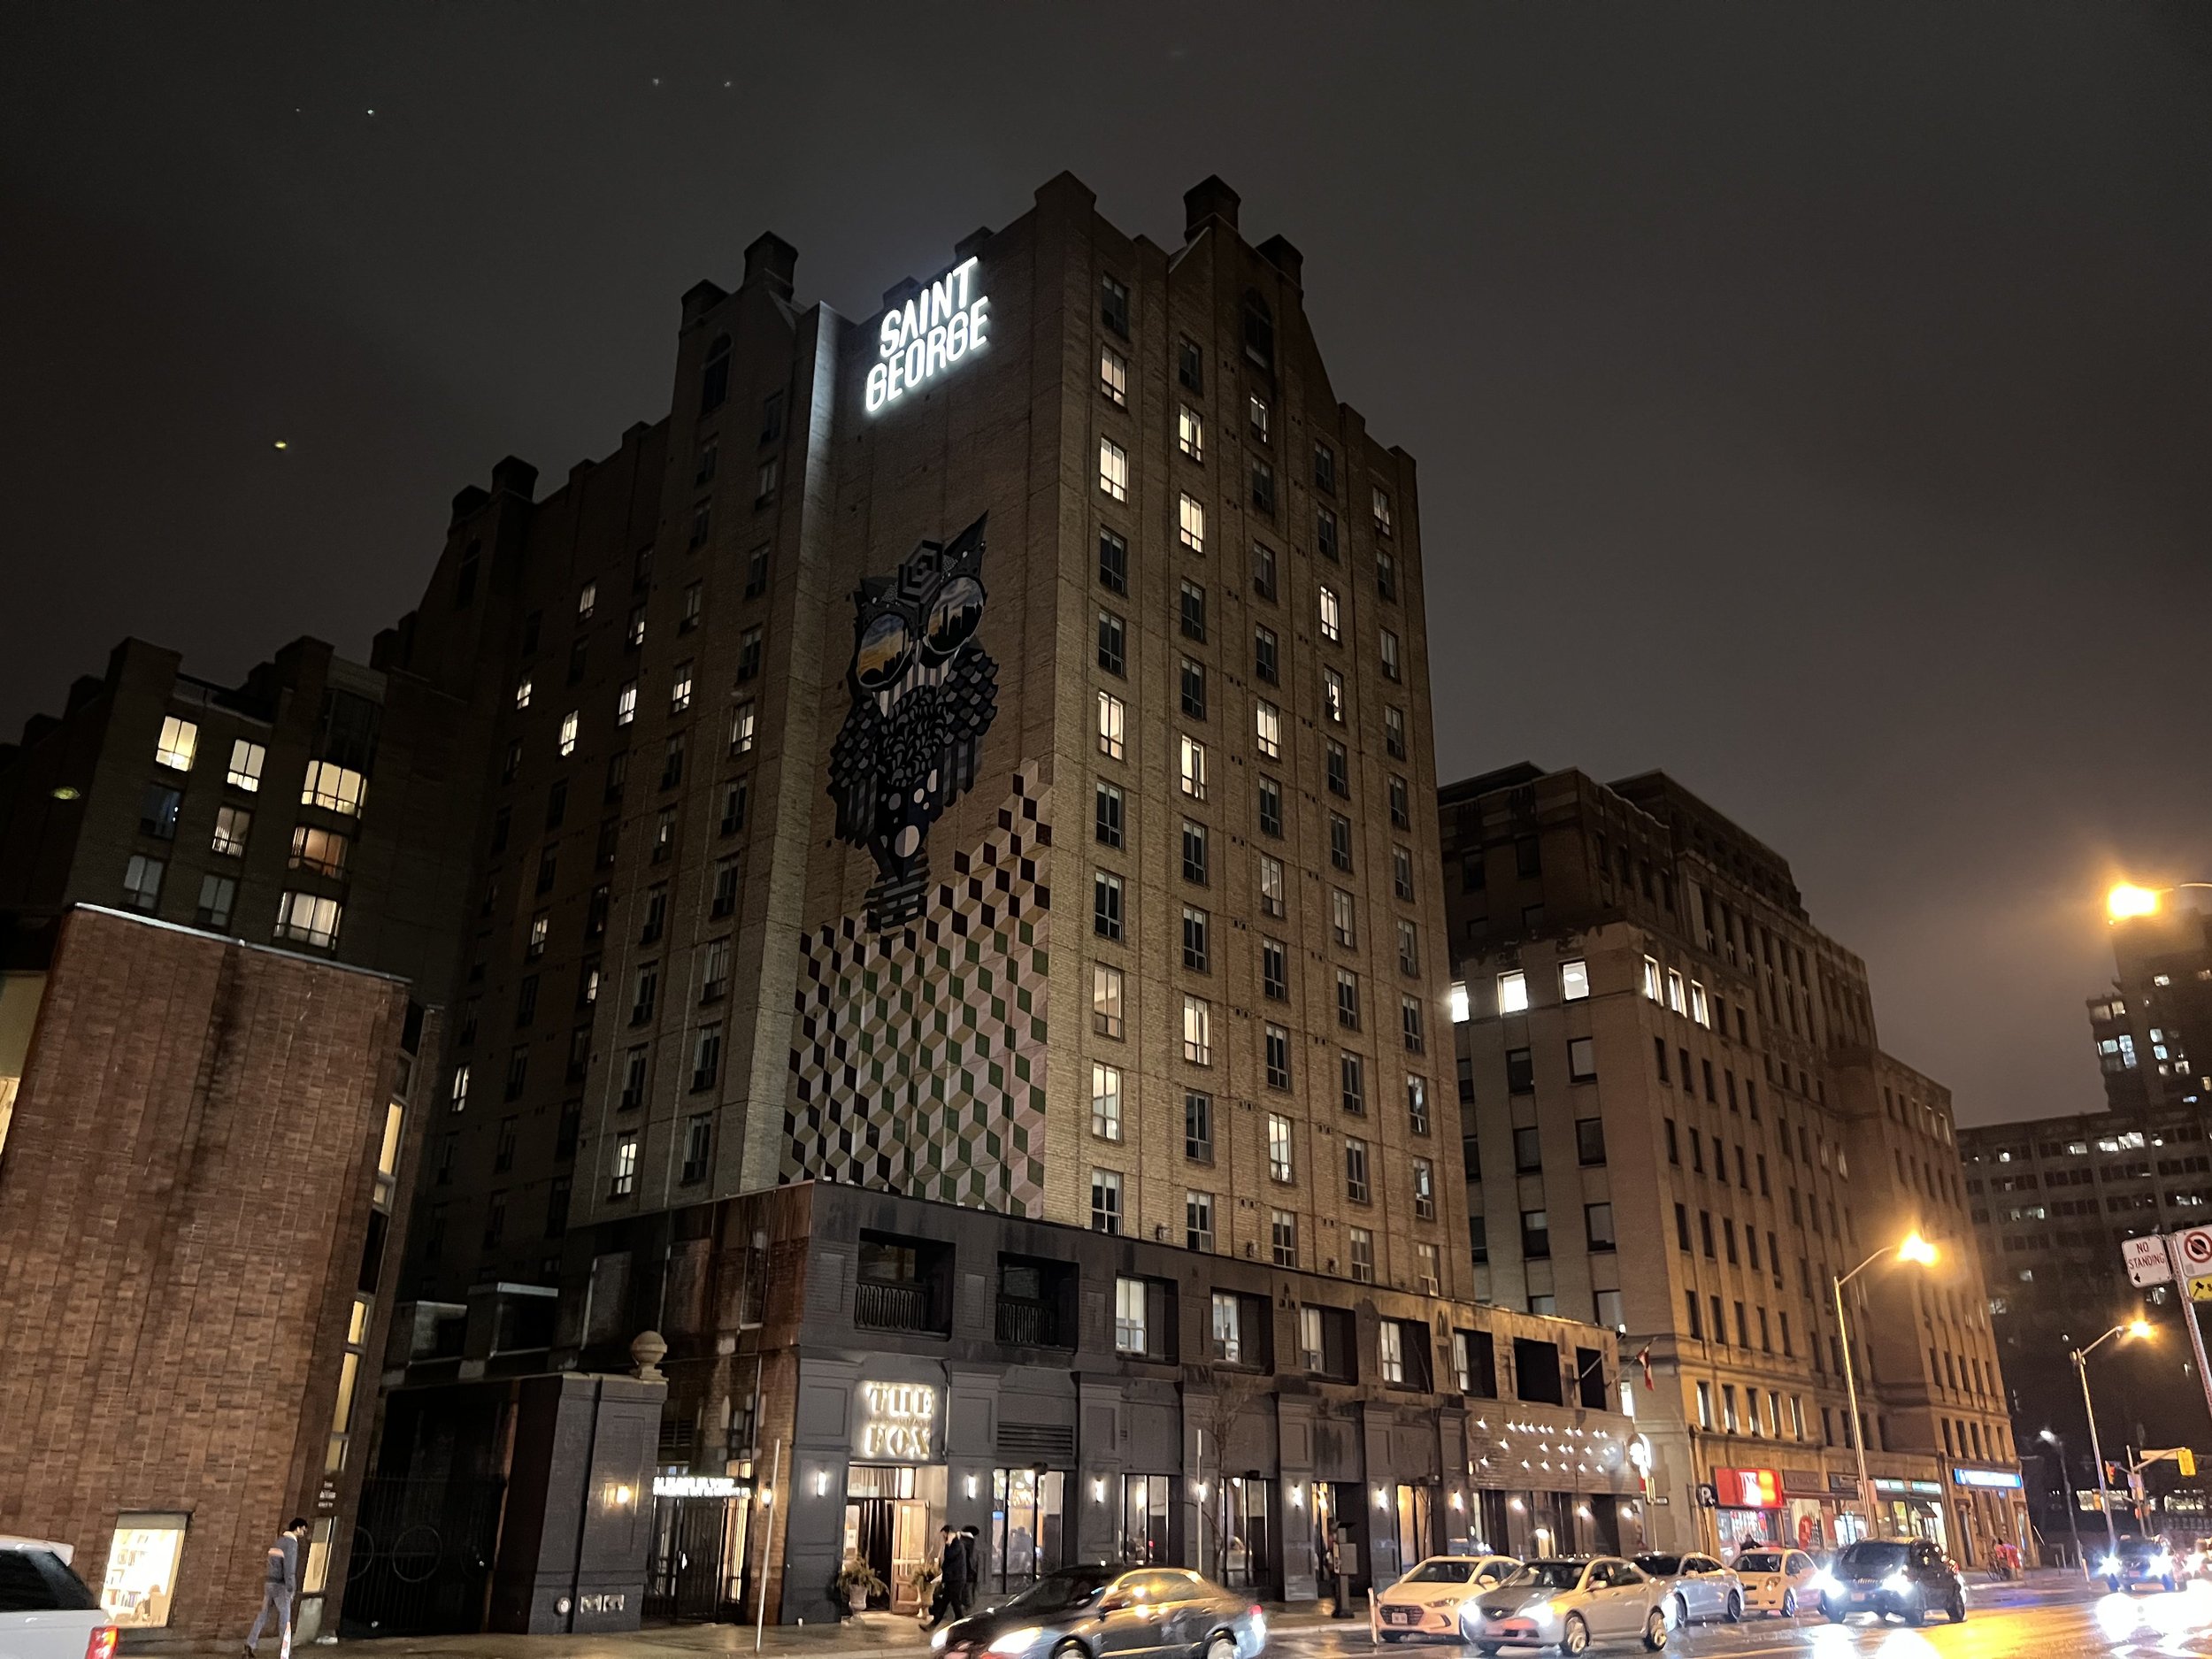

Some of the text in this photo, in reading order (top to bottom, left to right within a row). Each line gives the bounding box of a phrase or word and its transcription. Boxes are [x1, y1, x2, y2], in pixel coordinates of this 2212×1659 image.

[879, 255, 979, 358] SAINT
[864, 295, 989, 412] GEORGE
[2128, 1253, 2165, 1270] STANDING
[2136, 1241, 2149, 1253] NO
[864, 1424, 931, 1460] FOX
